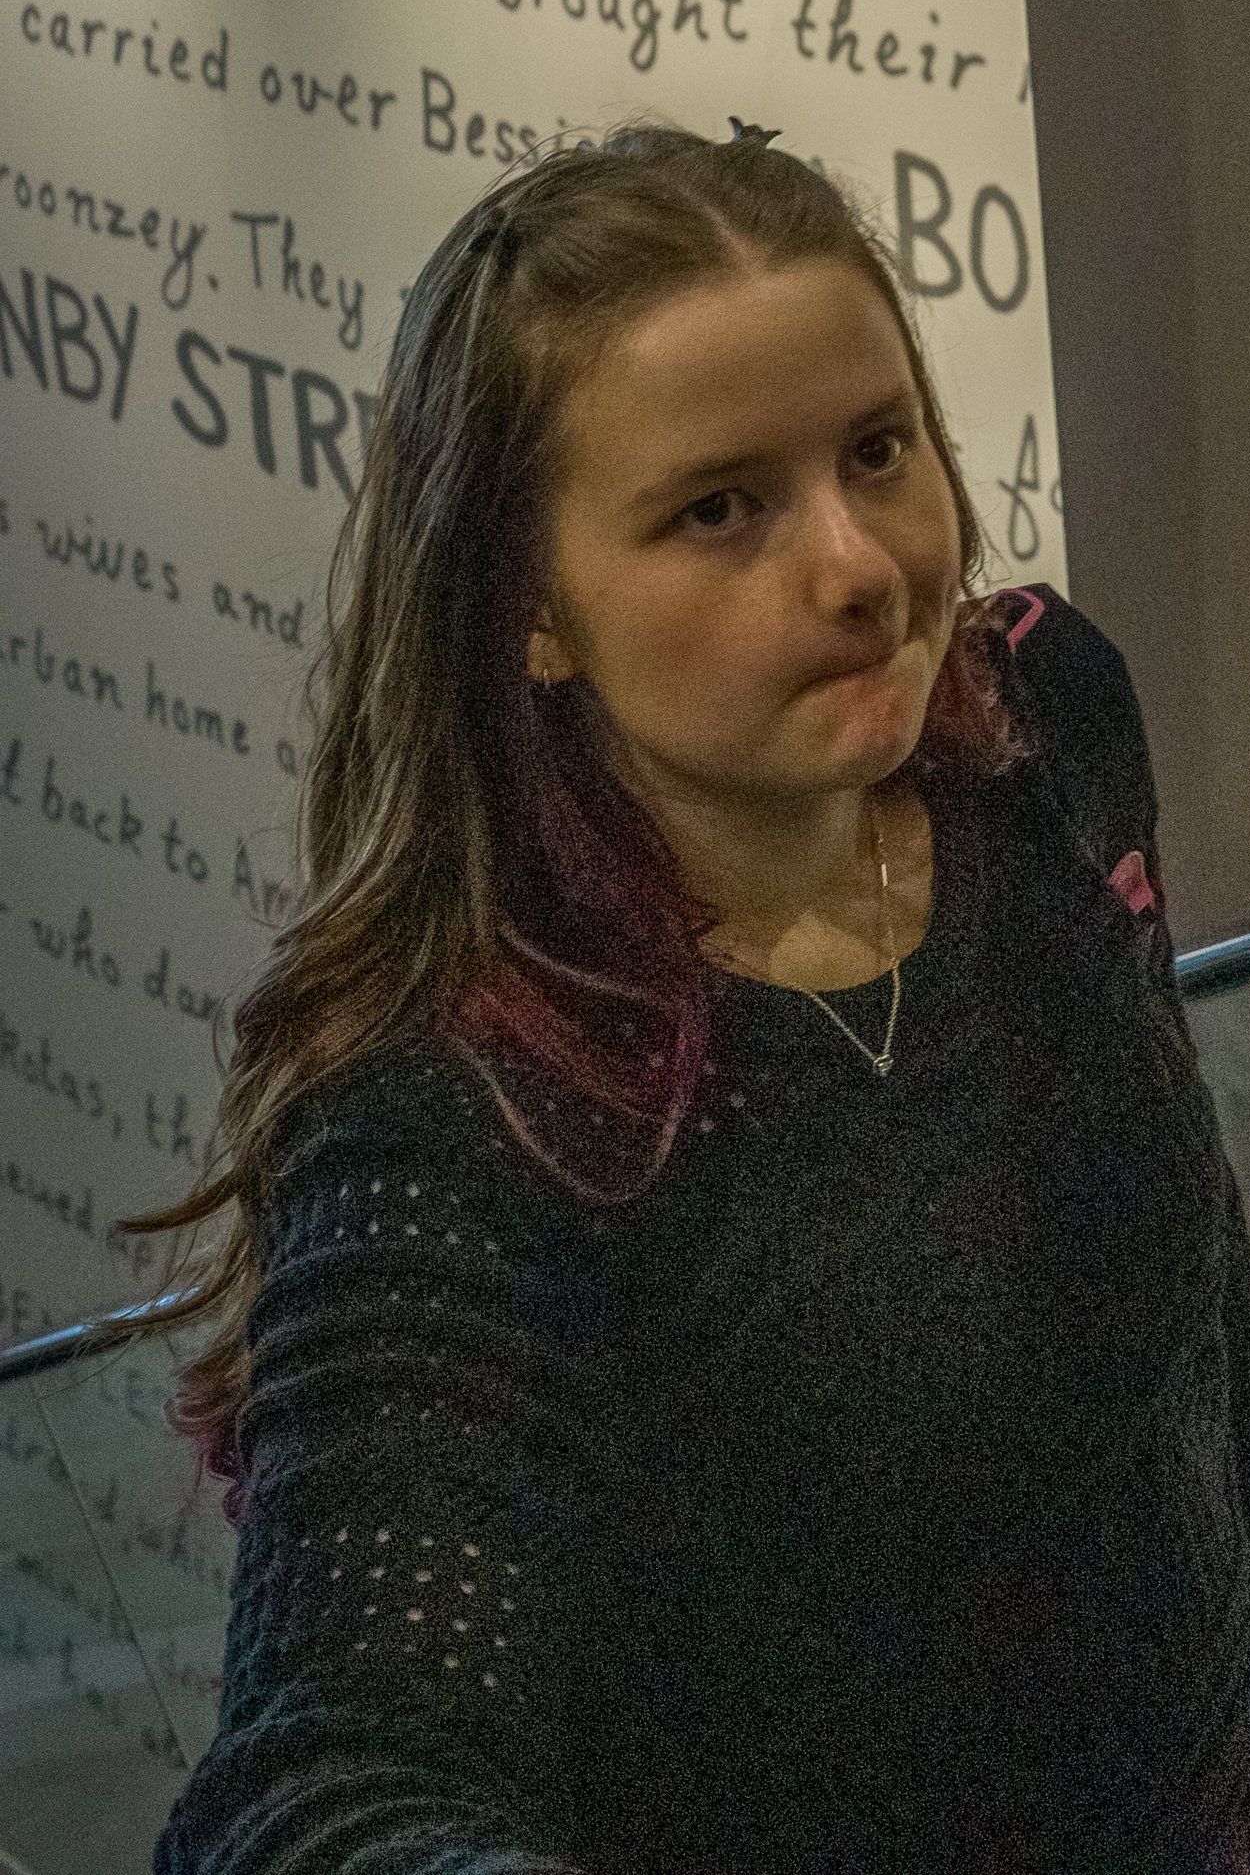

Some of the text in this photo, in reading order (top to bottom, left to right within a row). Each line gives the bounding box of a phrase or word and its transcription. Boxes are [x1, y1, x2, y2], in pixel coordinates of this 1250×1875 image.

[20, 2, 229, 93] carried
[259, 64, 397, 131] over
[894, 147, 1030, 314] BO
[0, 163, 219, 312] oonzey.
[229, 210, 364, 352] They
[36, 515, 304, 652] wives and
[145, 657, 250, 755] home
[41, 756, 143, 857] back
[160, 818, 209, 883] to
[30, 905, 123, 988] who
